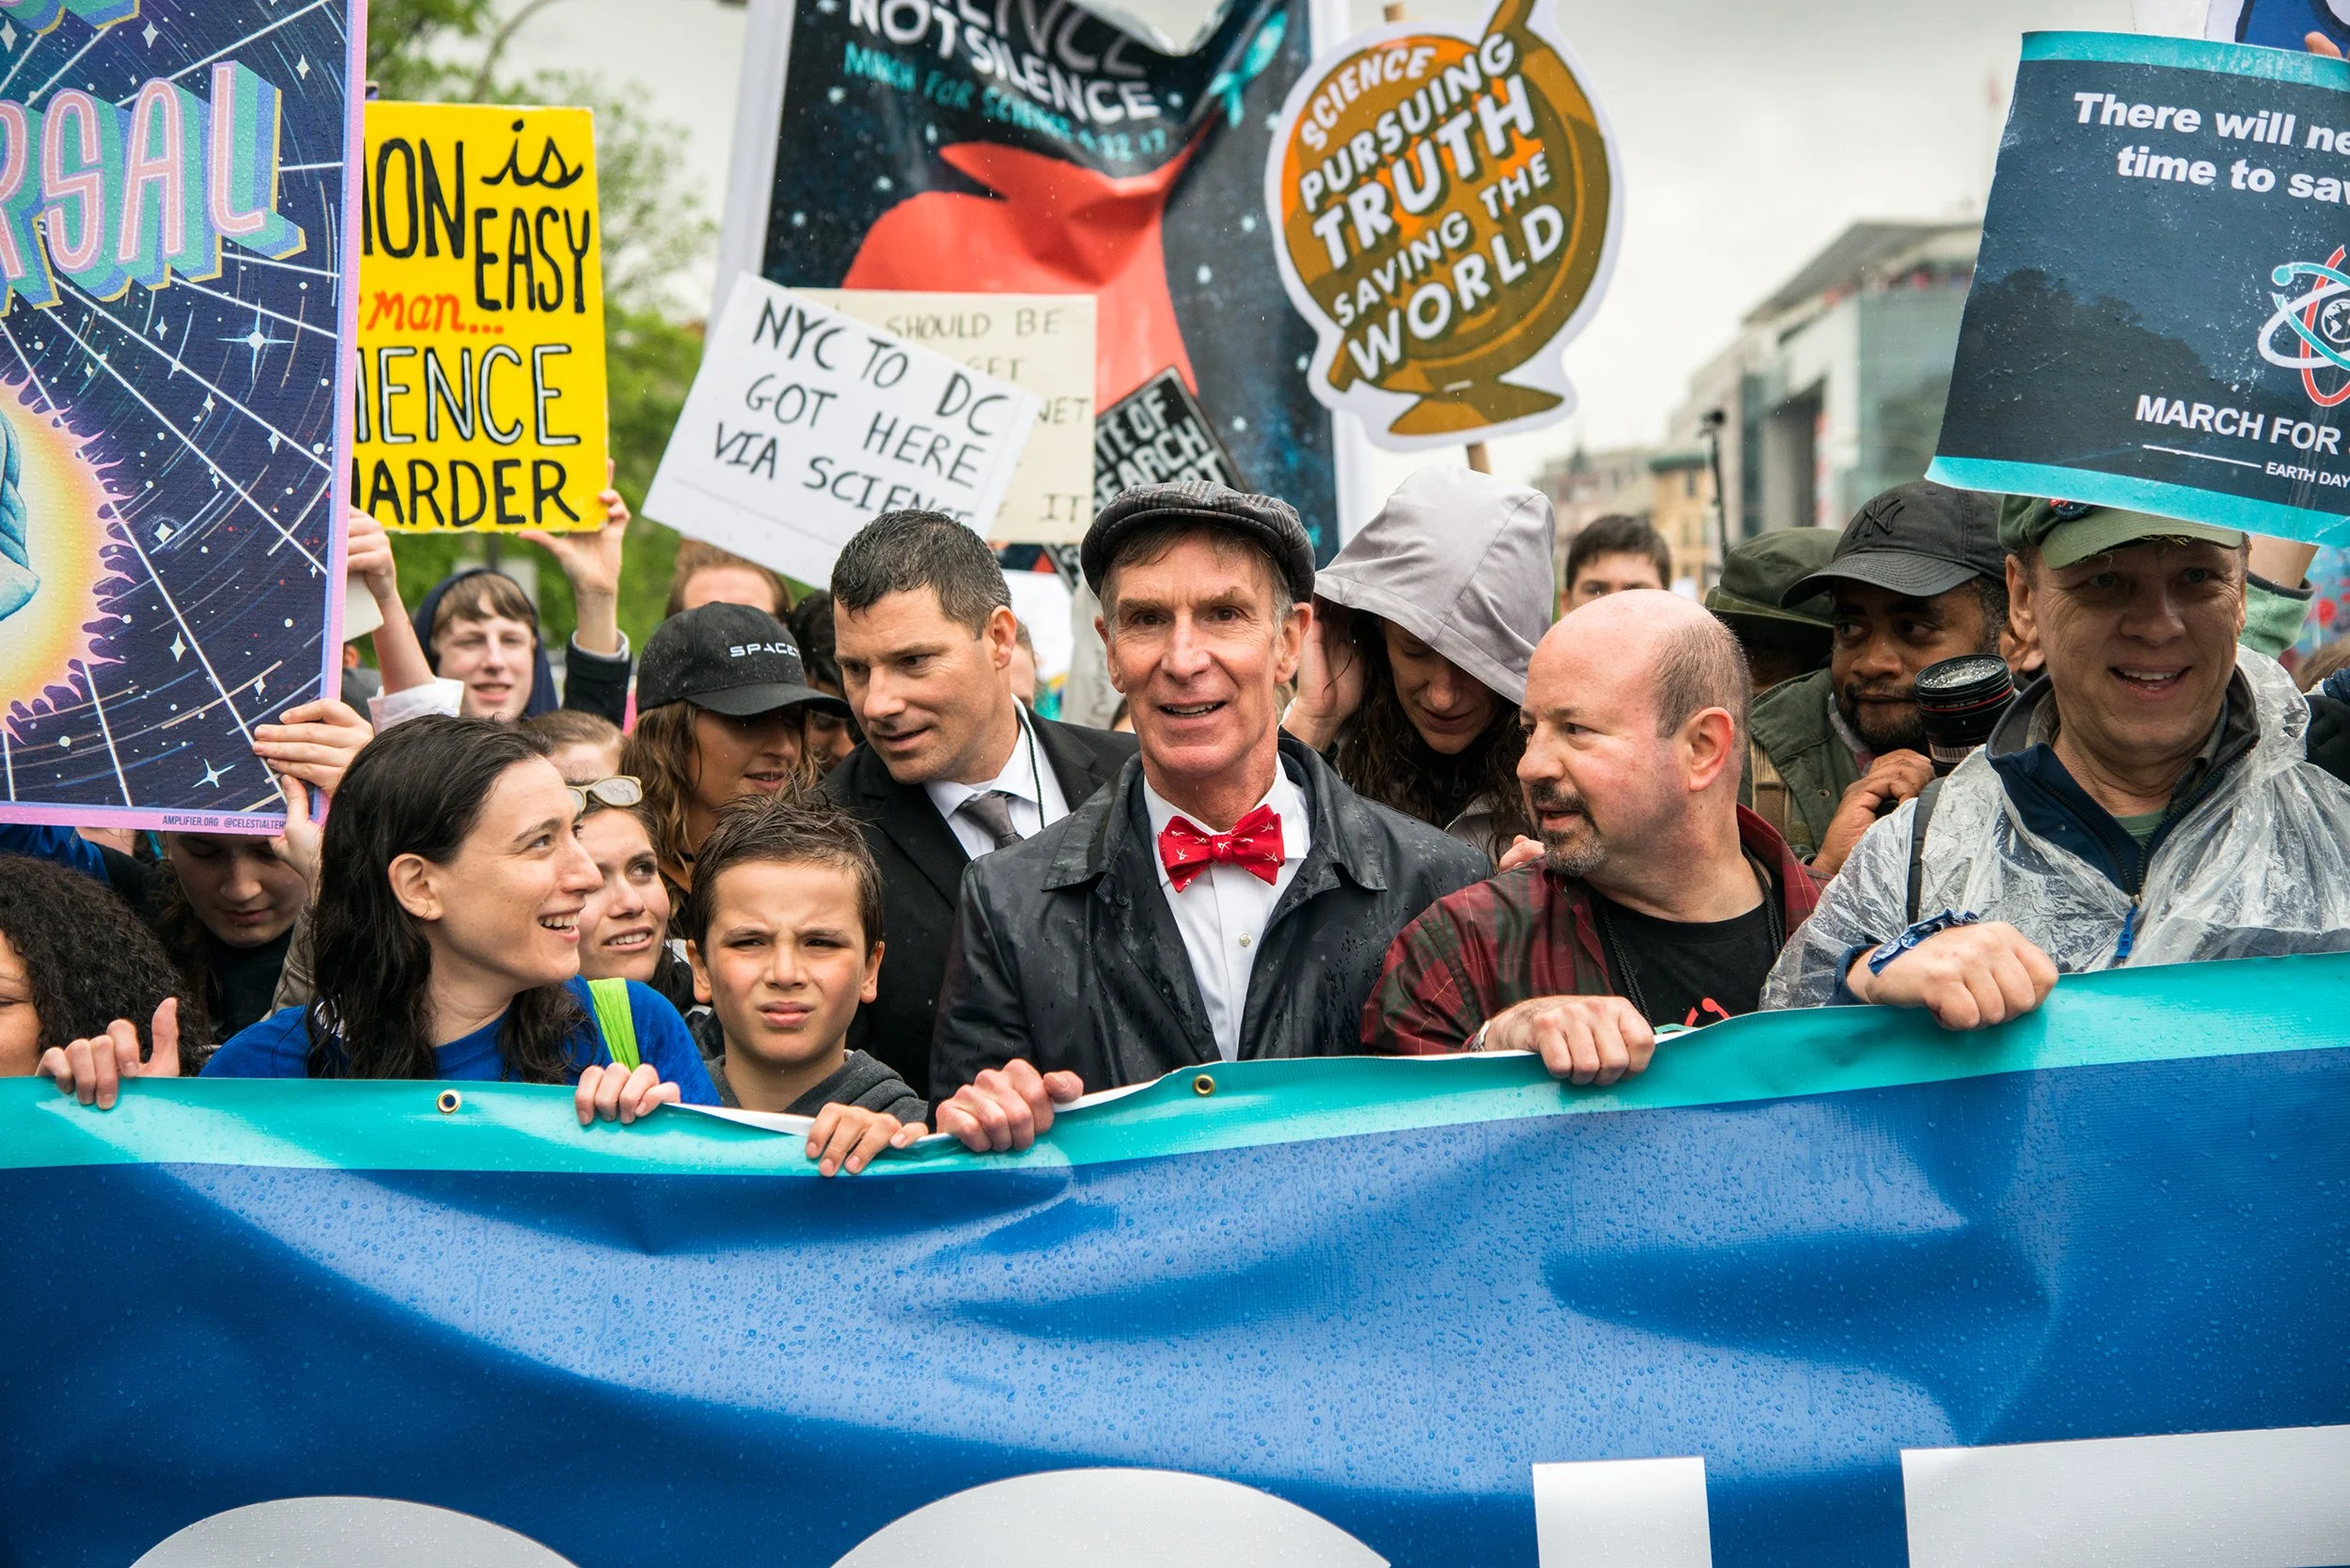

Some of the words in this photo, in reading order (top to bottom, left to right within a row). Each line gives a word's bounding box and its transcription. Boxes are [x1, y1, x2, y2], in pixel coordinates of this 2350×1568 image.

[964, 26, 1163, 124] SILENCE
[1299, 32, 1515, 213] PURSUING
[1300, 46, 1436, 151] SCIENCE
[2073, 91, 2201, 134] There
[2215, 110, 2295, 147] will
[480, 118, 584, 189] is
[1313, 73, 1535, 271] TRUTH
[2117, 145, 2217, 185] time
[2231, 159, 2276, 194] to
[475, 206, 590, 314] EASY
[1334, 212, 1468, 327] SAVING
[1480, 152, 1551, 220] THE
[885, 312, 992, 340] SHOULD
[1015, 308, 1064, 337] BE
[1348, 205, 1564, 380] WORLD
[753, 296, 848, 371] NYC
[860, 336, 909, 389] TO
[934, 371, 1010, 437] DC
[1127, 388, 1167, 441] OF
[714, 421, 778, 480] VIA
[802, 455, 974, 520] SCIEN
[745, 373, 838, 429] GOT
[863, 411, 986, 490] HERE
[2135, 395, 2263, 442] MARCH
[2270, 417, 2341, 456] FOR
[1039, 493, 1088, 524] IT
[2265, 461, 2317, 483] EARTH
[2318, 471, 2350, 489] DAY
[162, 815, 220, 827] AMPLIFIER.ORG
[223, 817, 287, 830] @CELESTIALTER
